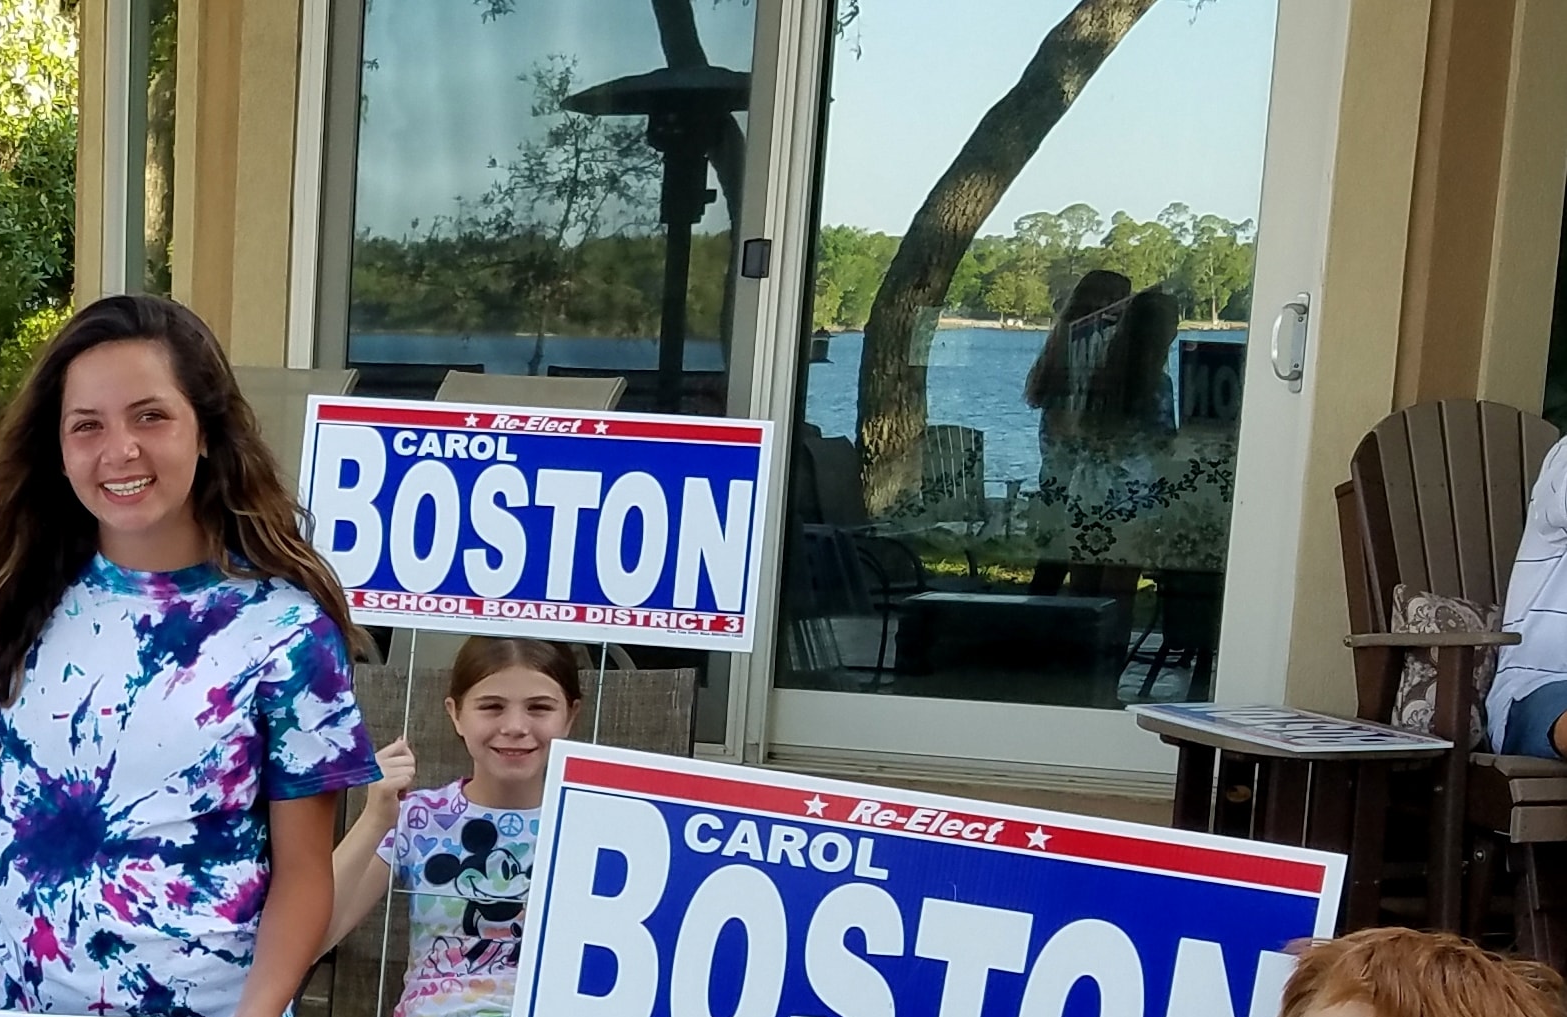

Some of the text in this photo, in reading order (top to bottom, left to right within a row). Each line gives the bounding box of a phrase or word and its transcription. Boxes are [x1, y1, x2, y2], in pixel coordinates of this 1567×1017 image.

[491, 413, 583, 434] Re-Elect
[393, 430, 518, 462] CAROL
[312, 424, 755, 612] BOSTON
[363, 592, 473, 616] SCHOOL
[483, 598, 576, 623] BOARD
[586, 604, 717, 632] DISTRICT
[725, 616, 742, 634] 3
[849, 799, 1007, 843] Re-Elect
[684, 813, 890, 881] CAROL
